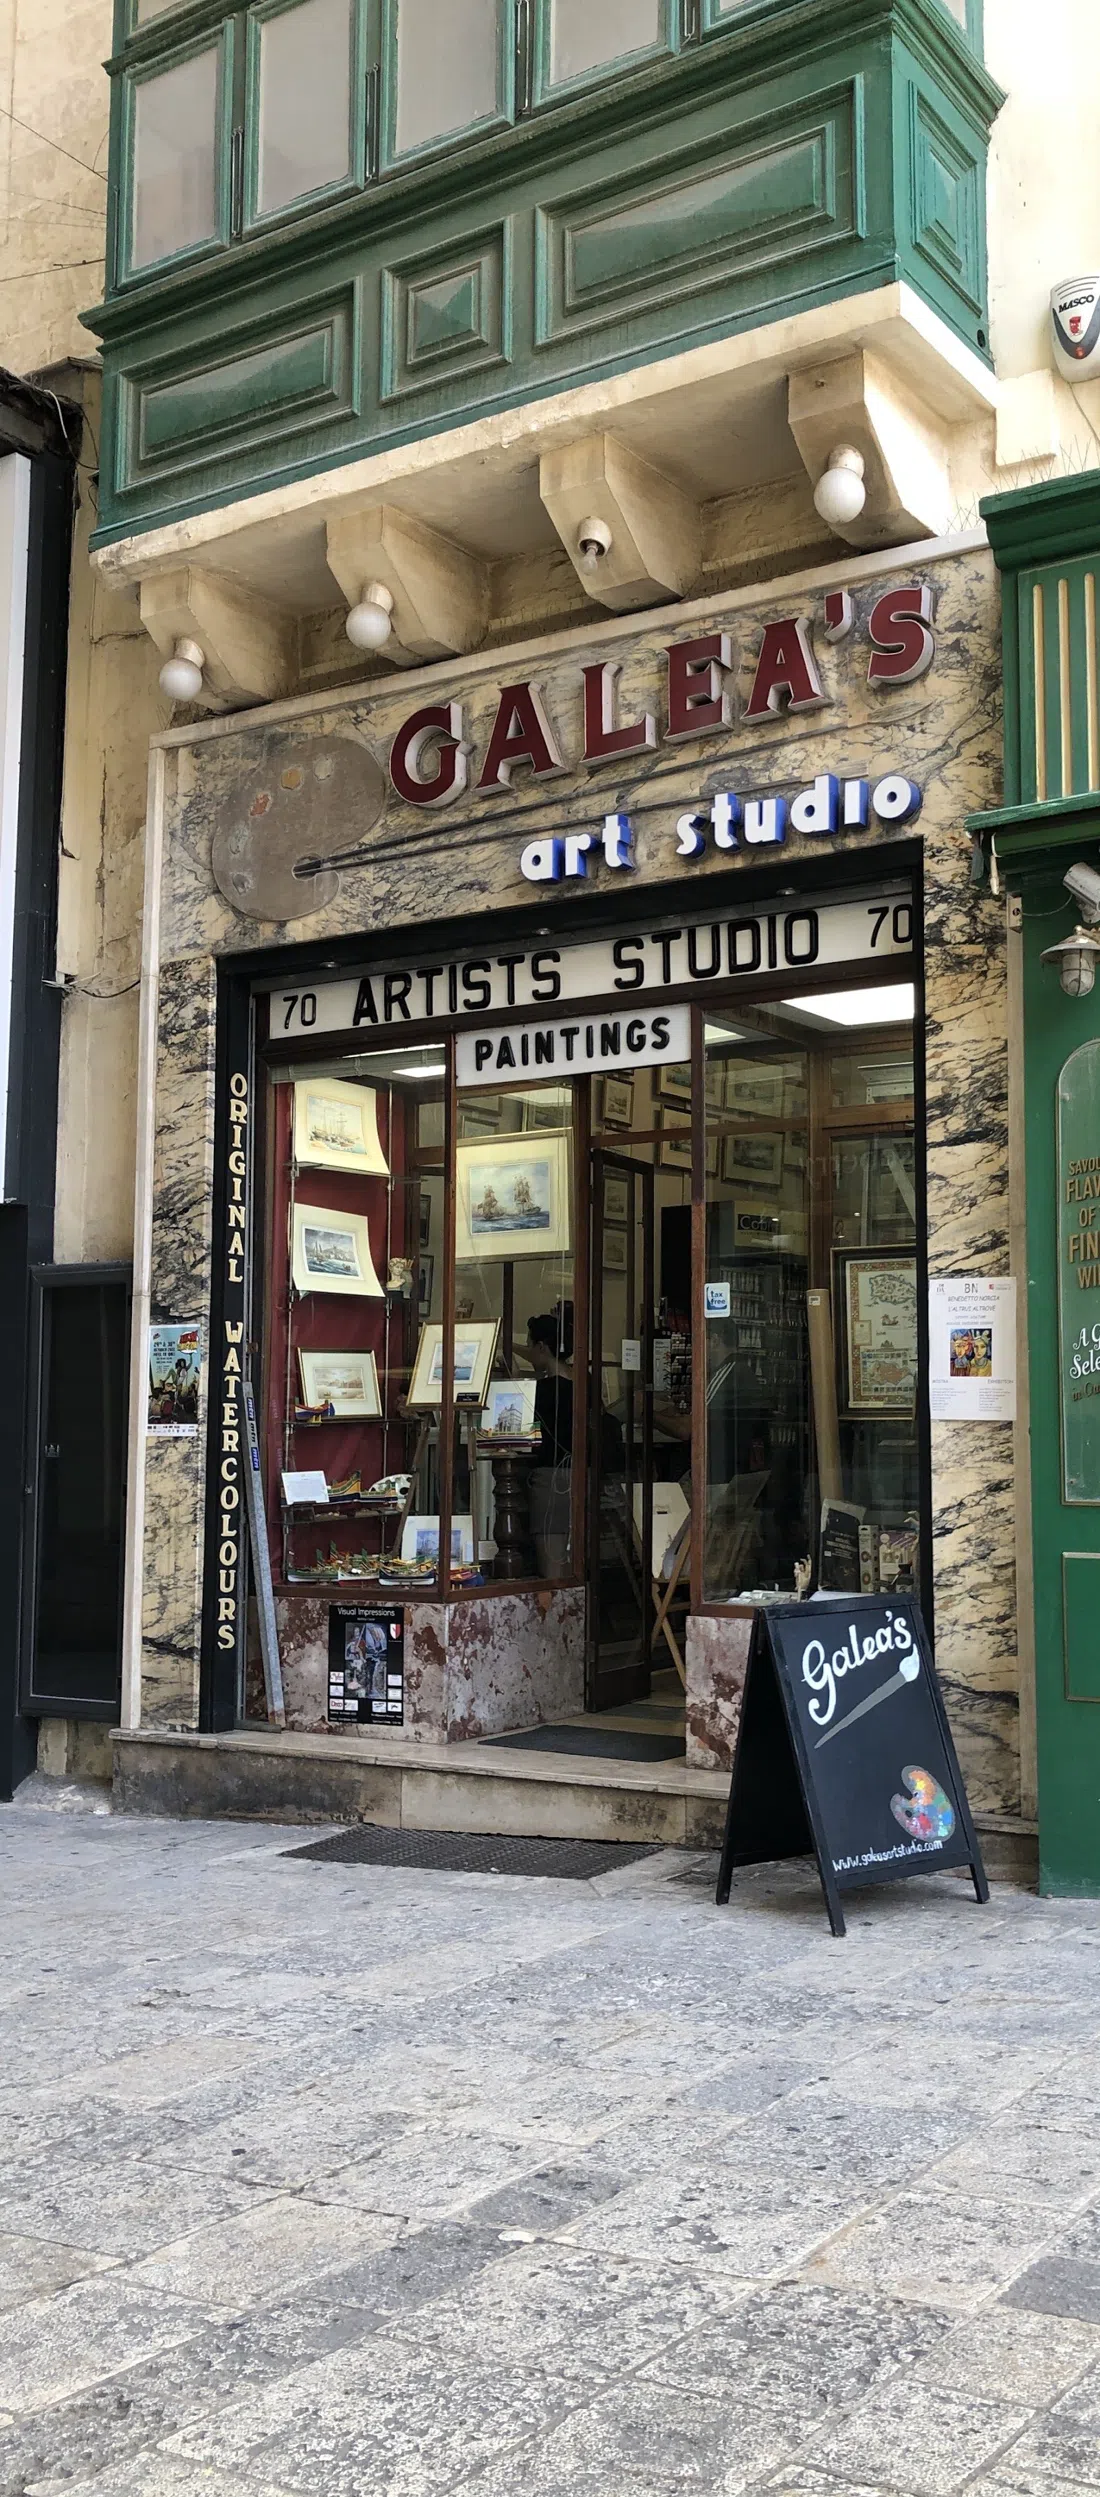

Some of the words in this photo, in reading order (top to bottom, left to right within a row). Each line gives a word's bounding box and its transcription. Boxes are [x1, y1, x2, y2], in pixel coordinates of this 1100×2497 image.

[1058, 295, 1095, 313] MASCO
[390, 585, 934, 808] GALEA'S
[520, 814, 635, 882] art
[676, 774, 921, 858] studio
[282, 992, 317, 1029] 70
[352, 950, 562, 1026] ARTISTS
[614, 909, 820, 989] STUDIO
[867, 903, 913, 948] 70
[475, 1016, 671, 1072] PAINTINGS
[227, 1072, 248, 1283] ORIGINAL
[1079, 1205, 1096, 1228] OF
[711, 1290, 723, 1298] tax
[964, 1283, 979, 1294] BN
[217, 1320, 244, 1650] WATERCOLOURS
[337, 1607, 357, 1616] Visual
[358, 1607, 396, 1617] Impressions
[801, 1611, 912, 1725] Galea's
